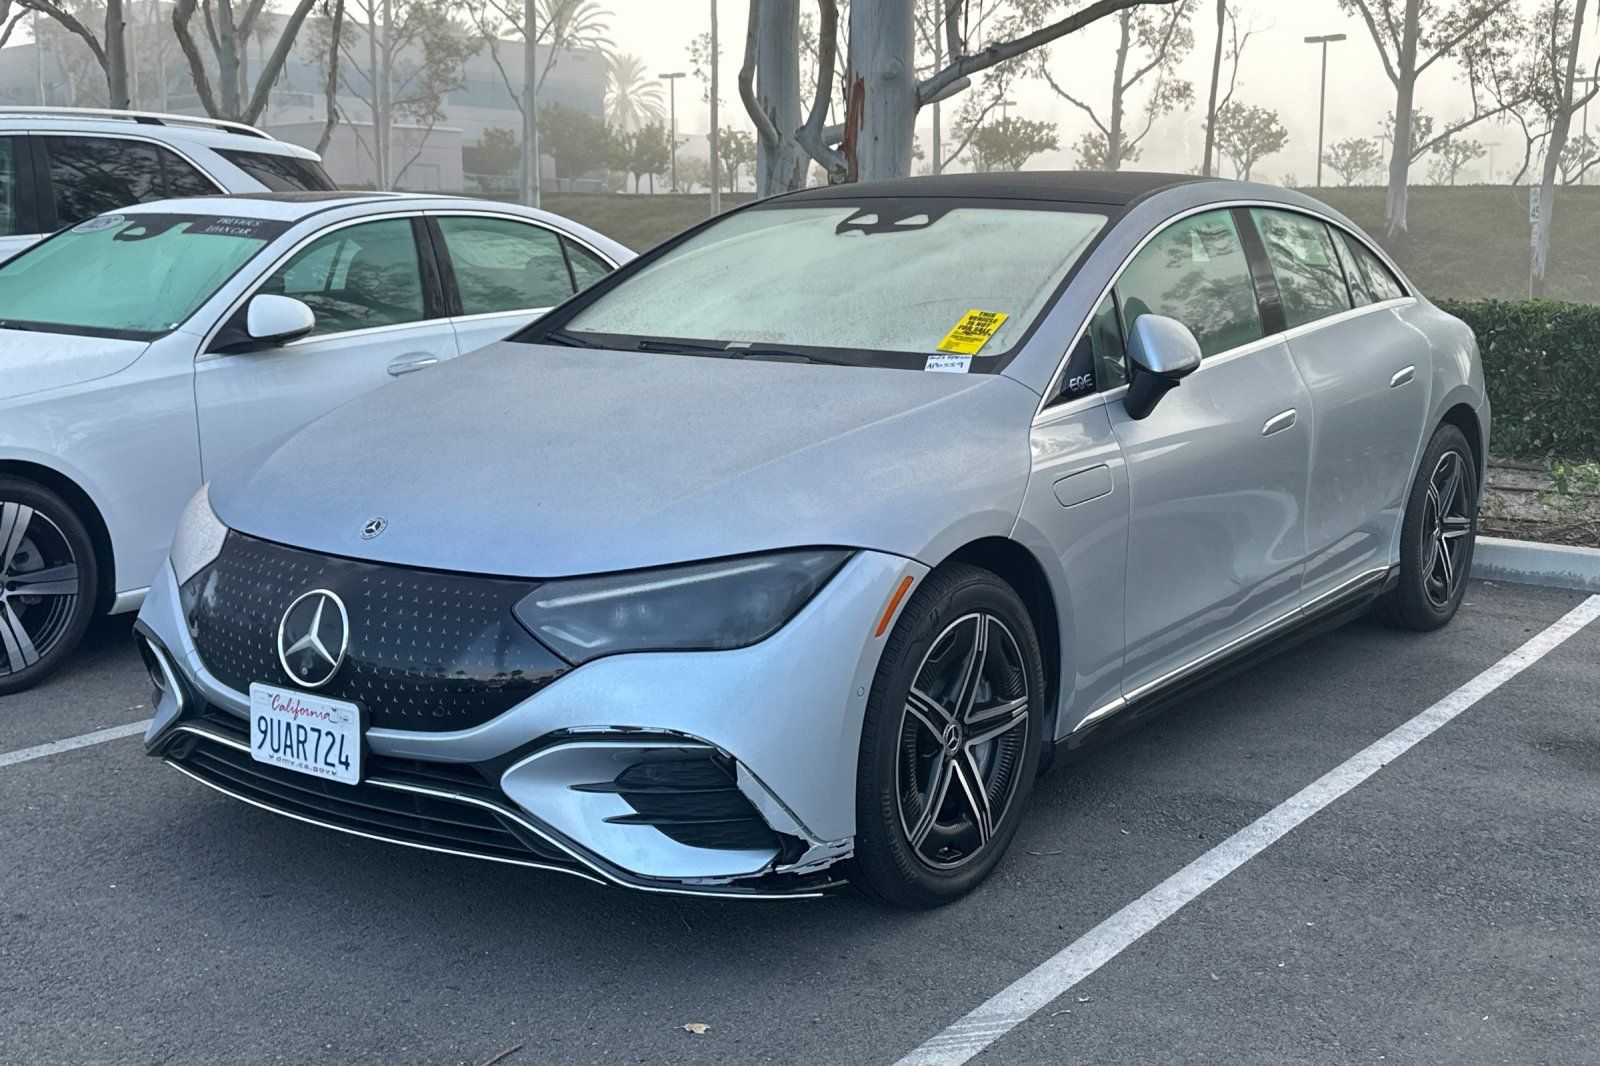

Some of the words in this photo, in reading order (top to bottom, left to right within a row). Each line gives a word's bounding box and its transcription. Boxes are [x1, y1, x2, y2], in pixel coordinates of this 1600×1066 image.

[968, 316, 998, 324] VEHICLE
[1070, 374, 1092, 390] EQE
[271, 694, 338, 724] California
[257, 715, 351, 771] 9UAR724
[276, 756, 332, 774] dmv.ca.gov
